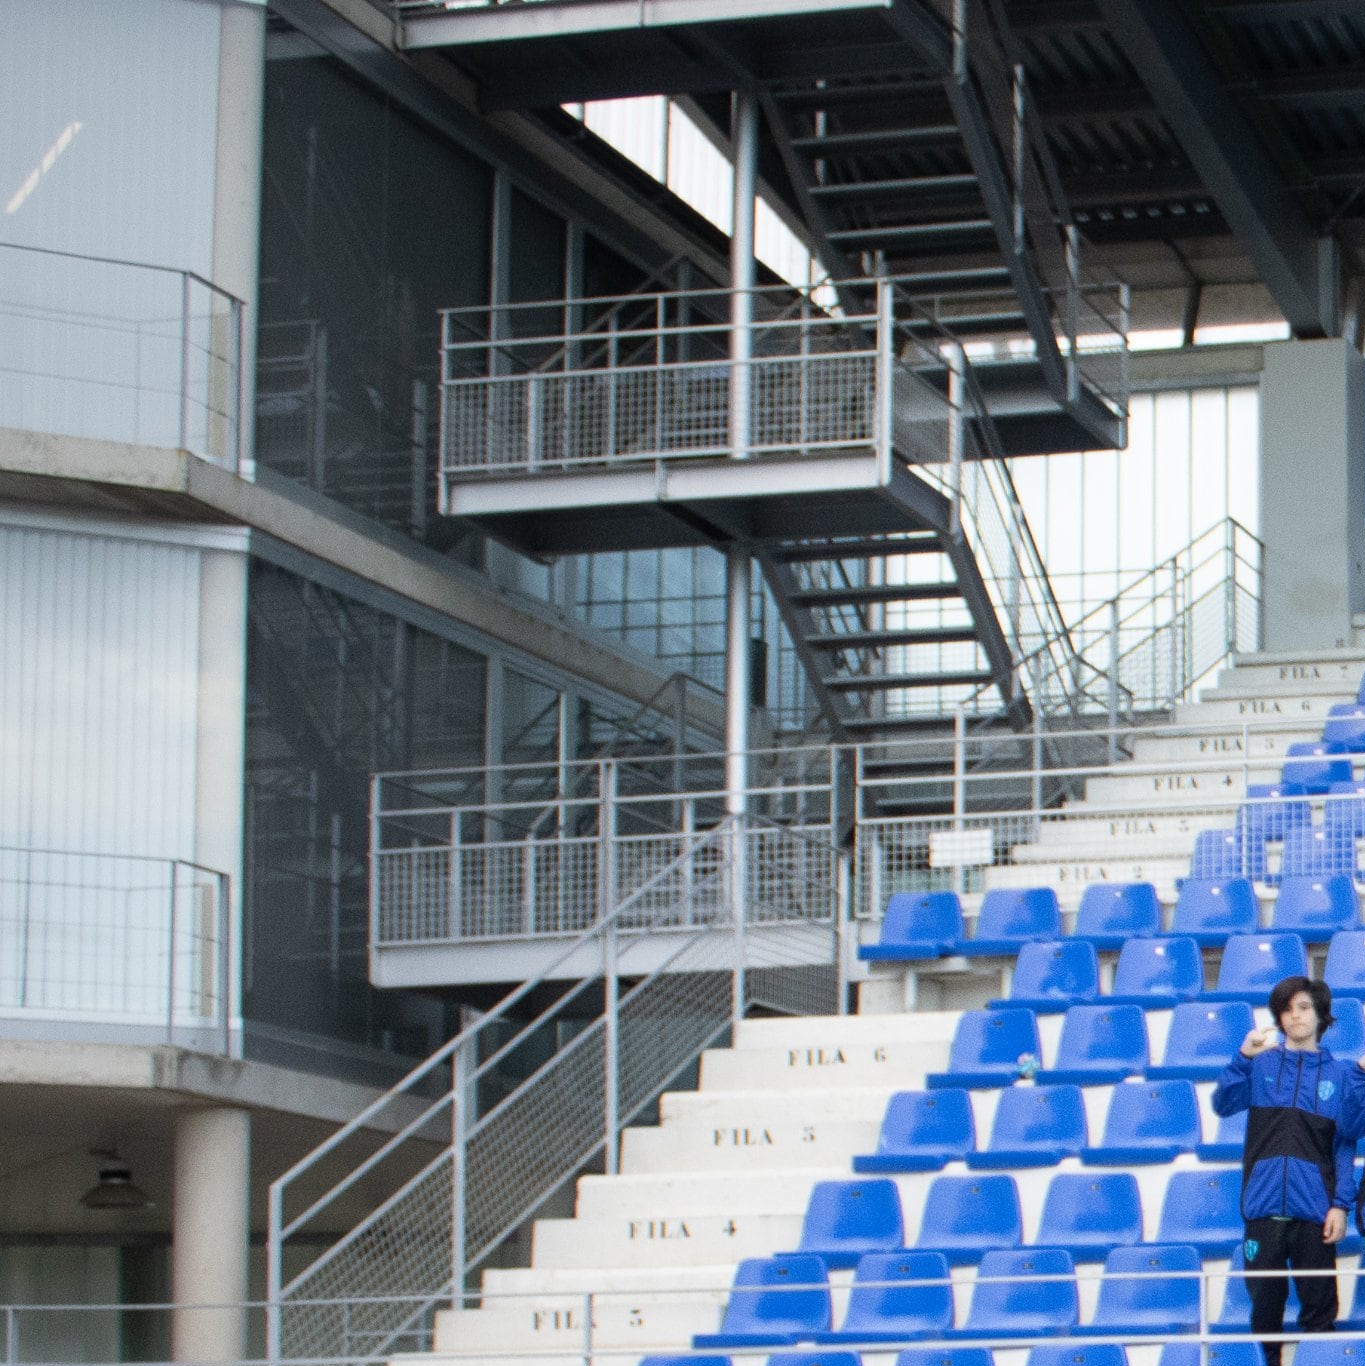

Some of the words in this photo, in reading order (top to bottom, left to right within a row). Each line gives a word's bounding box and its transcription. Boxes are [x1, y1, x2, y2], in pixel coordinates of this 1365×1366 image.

[1279, 665, 1320, 680] FILA
[1239, 699, 1282, 714] FILA
[1200, 737, 1243, 752] FILA
[1153, 775, 1199, 790] FILA
[1223, 775, 1233, 787] 4
[1109, 818, 1156, 836] FILA
[1059, 864, 1107, 882] FILA
[788, 1048, 846, 1067] FILA
[874, 1047, 887, 1062] 6
[713, 1128, 773, 1147] FILA
[802, 1126, 815, 1142] 5
[629, 1220, 691, 1240] FILA
[724, 1220, 737, 1237] 4
